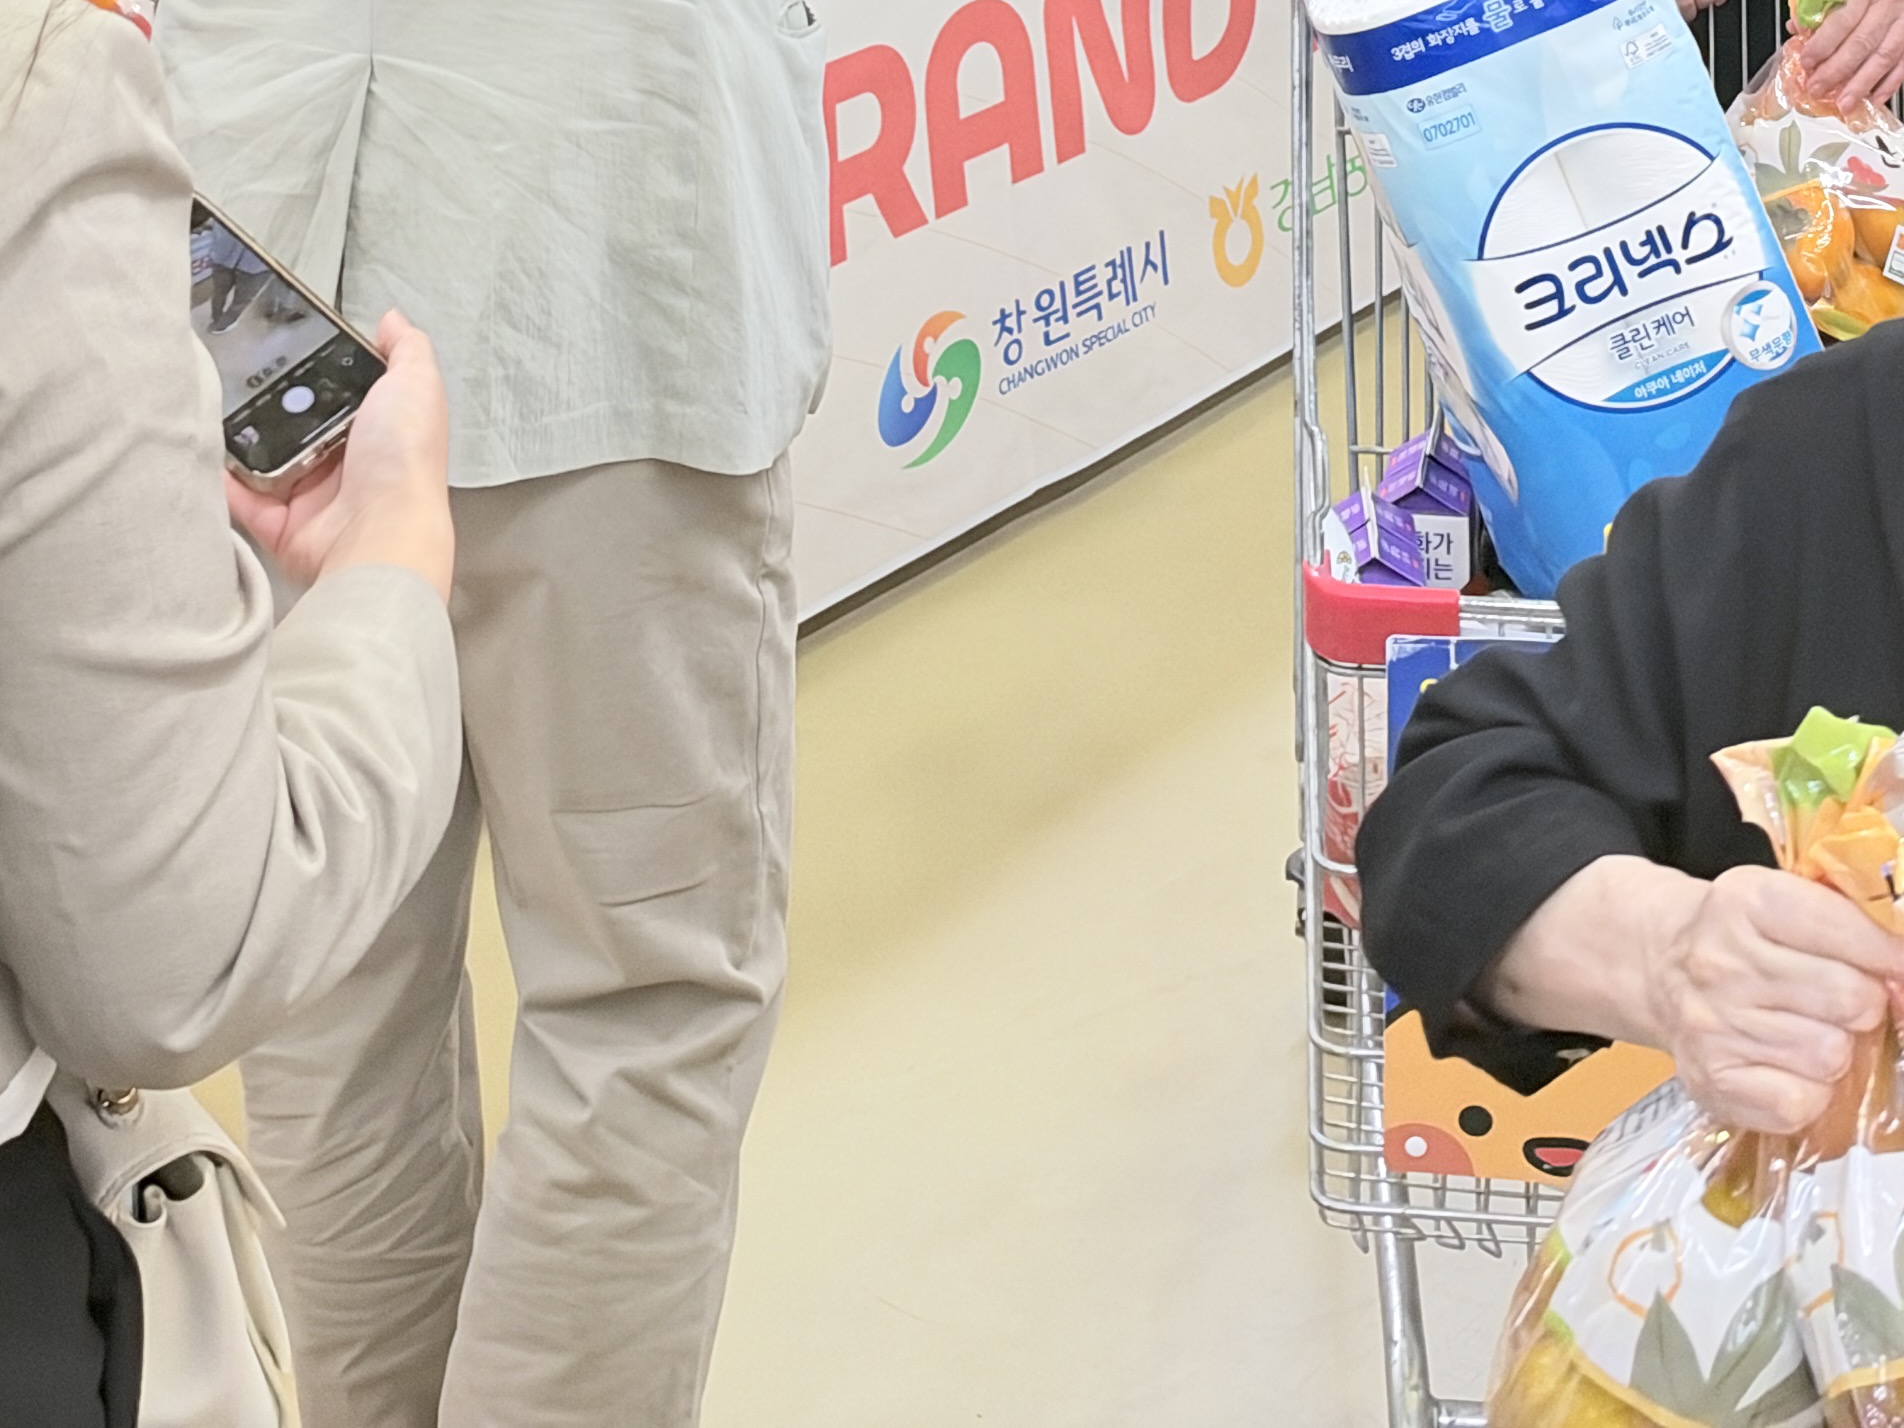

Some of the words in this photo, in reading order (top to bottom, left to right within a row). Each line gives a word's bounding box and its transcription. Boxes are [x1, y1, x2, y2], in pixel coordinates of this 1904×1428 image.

[1390, 37, 1426, 62] 3겹의
[1426, 17, 1480, 50] 화장지를
[1422, 111, 1477, 143] 0702701
[992, 229, 1170, 367] 창원특례시
[1514, 210, 1734, 332] 크리넥스
[998, 343, 1080, 396] CHANGWON
[1081, 318, 1131, 356] SPECIAL
[1130, 301, 1157, 329] CITY
[1609, 324, 1653, 362] 클린
[1651, 305, 1696, 339] 케어
[1634, 378, 1671, 400] 아쿠아
[1671, 359, 1708, 387] 네이처
